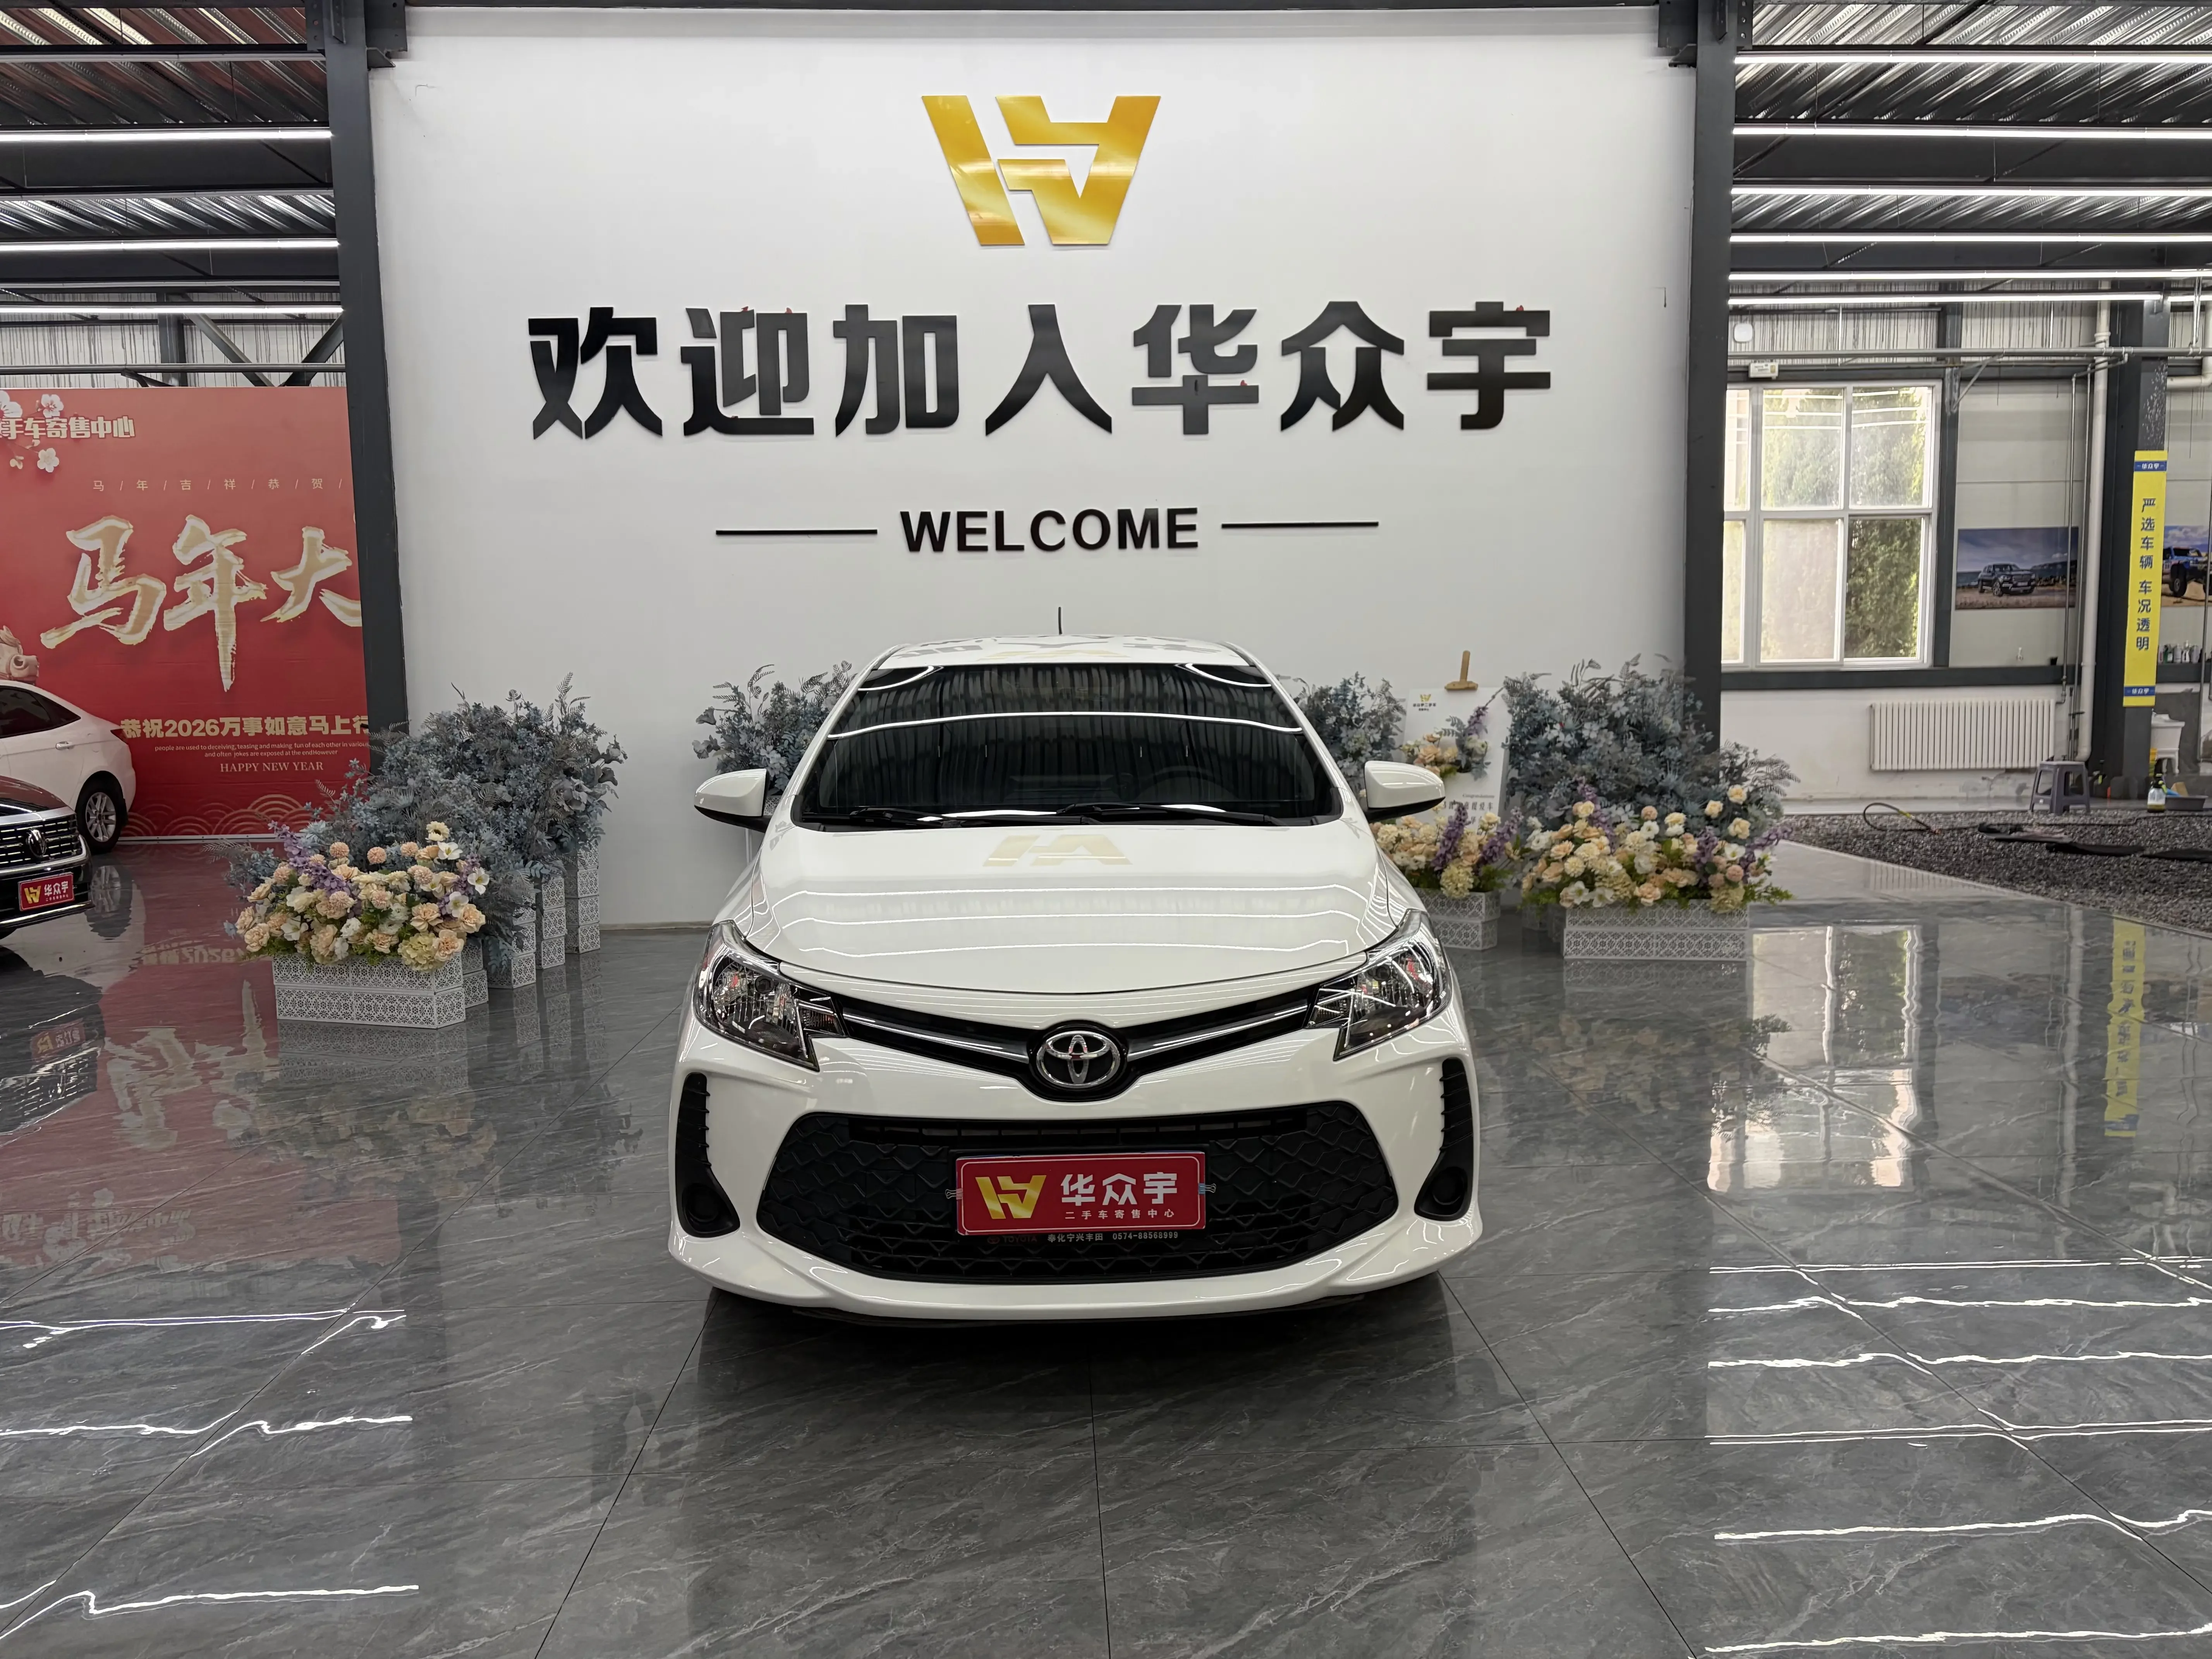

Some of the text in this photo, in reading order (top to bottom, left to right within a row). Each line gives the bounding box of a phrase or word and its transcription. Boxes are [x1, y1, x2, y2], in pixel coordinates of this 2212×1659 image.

[528, 302, 1550, 439] 欢迎加入华众宇
[900, 508, 1198, 552] WELCOME
[220, 761, 324, 772] HAPPY NEW YEAR
[44, 881, 69, 896] 华众宇
[1060, 1171, 1178, 1206] 华众宇
[1065, 1208, 1175, 1219] 二手车寄售中心
[1047, 1231, 1178, 1243] 奉化宁兴丰田 0574-88568999
